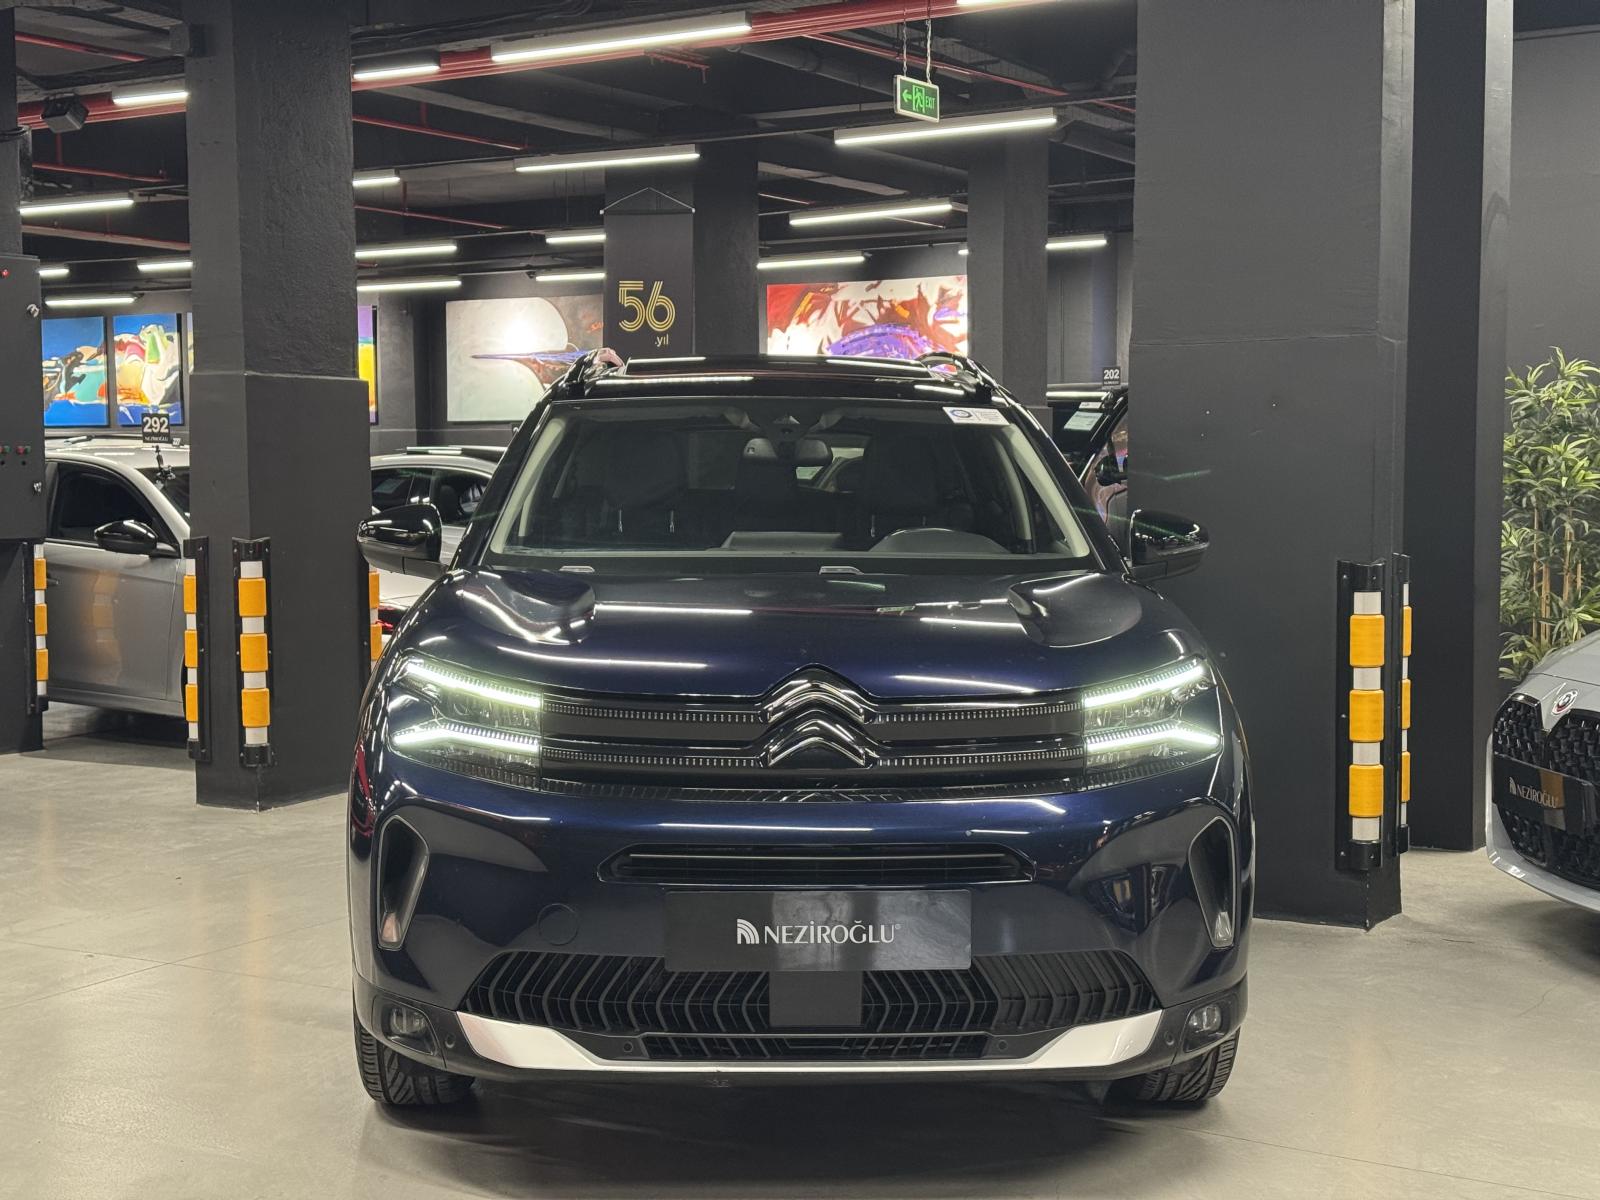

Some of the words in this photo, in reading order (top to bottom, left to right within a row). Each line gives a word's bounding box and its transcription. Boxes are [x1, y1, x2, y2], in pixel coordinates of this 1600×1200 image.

[926, 96, 936, 110] EXIT
[619, 281, 676, 332] 56
[1104, 369, 1120, 380] 202
[143, 416, 169, 433] 292
